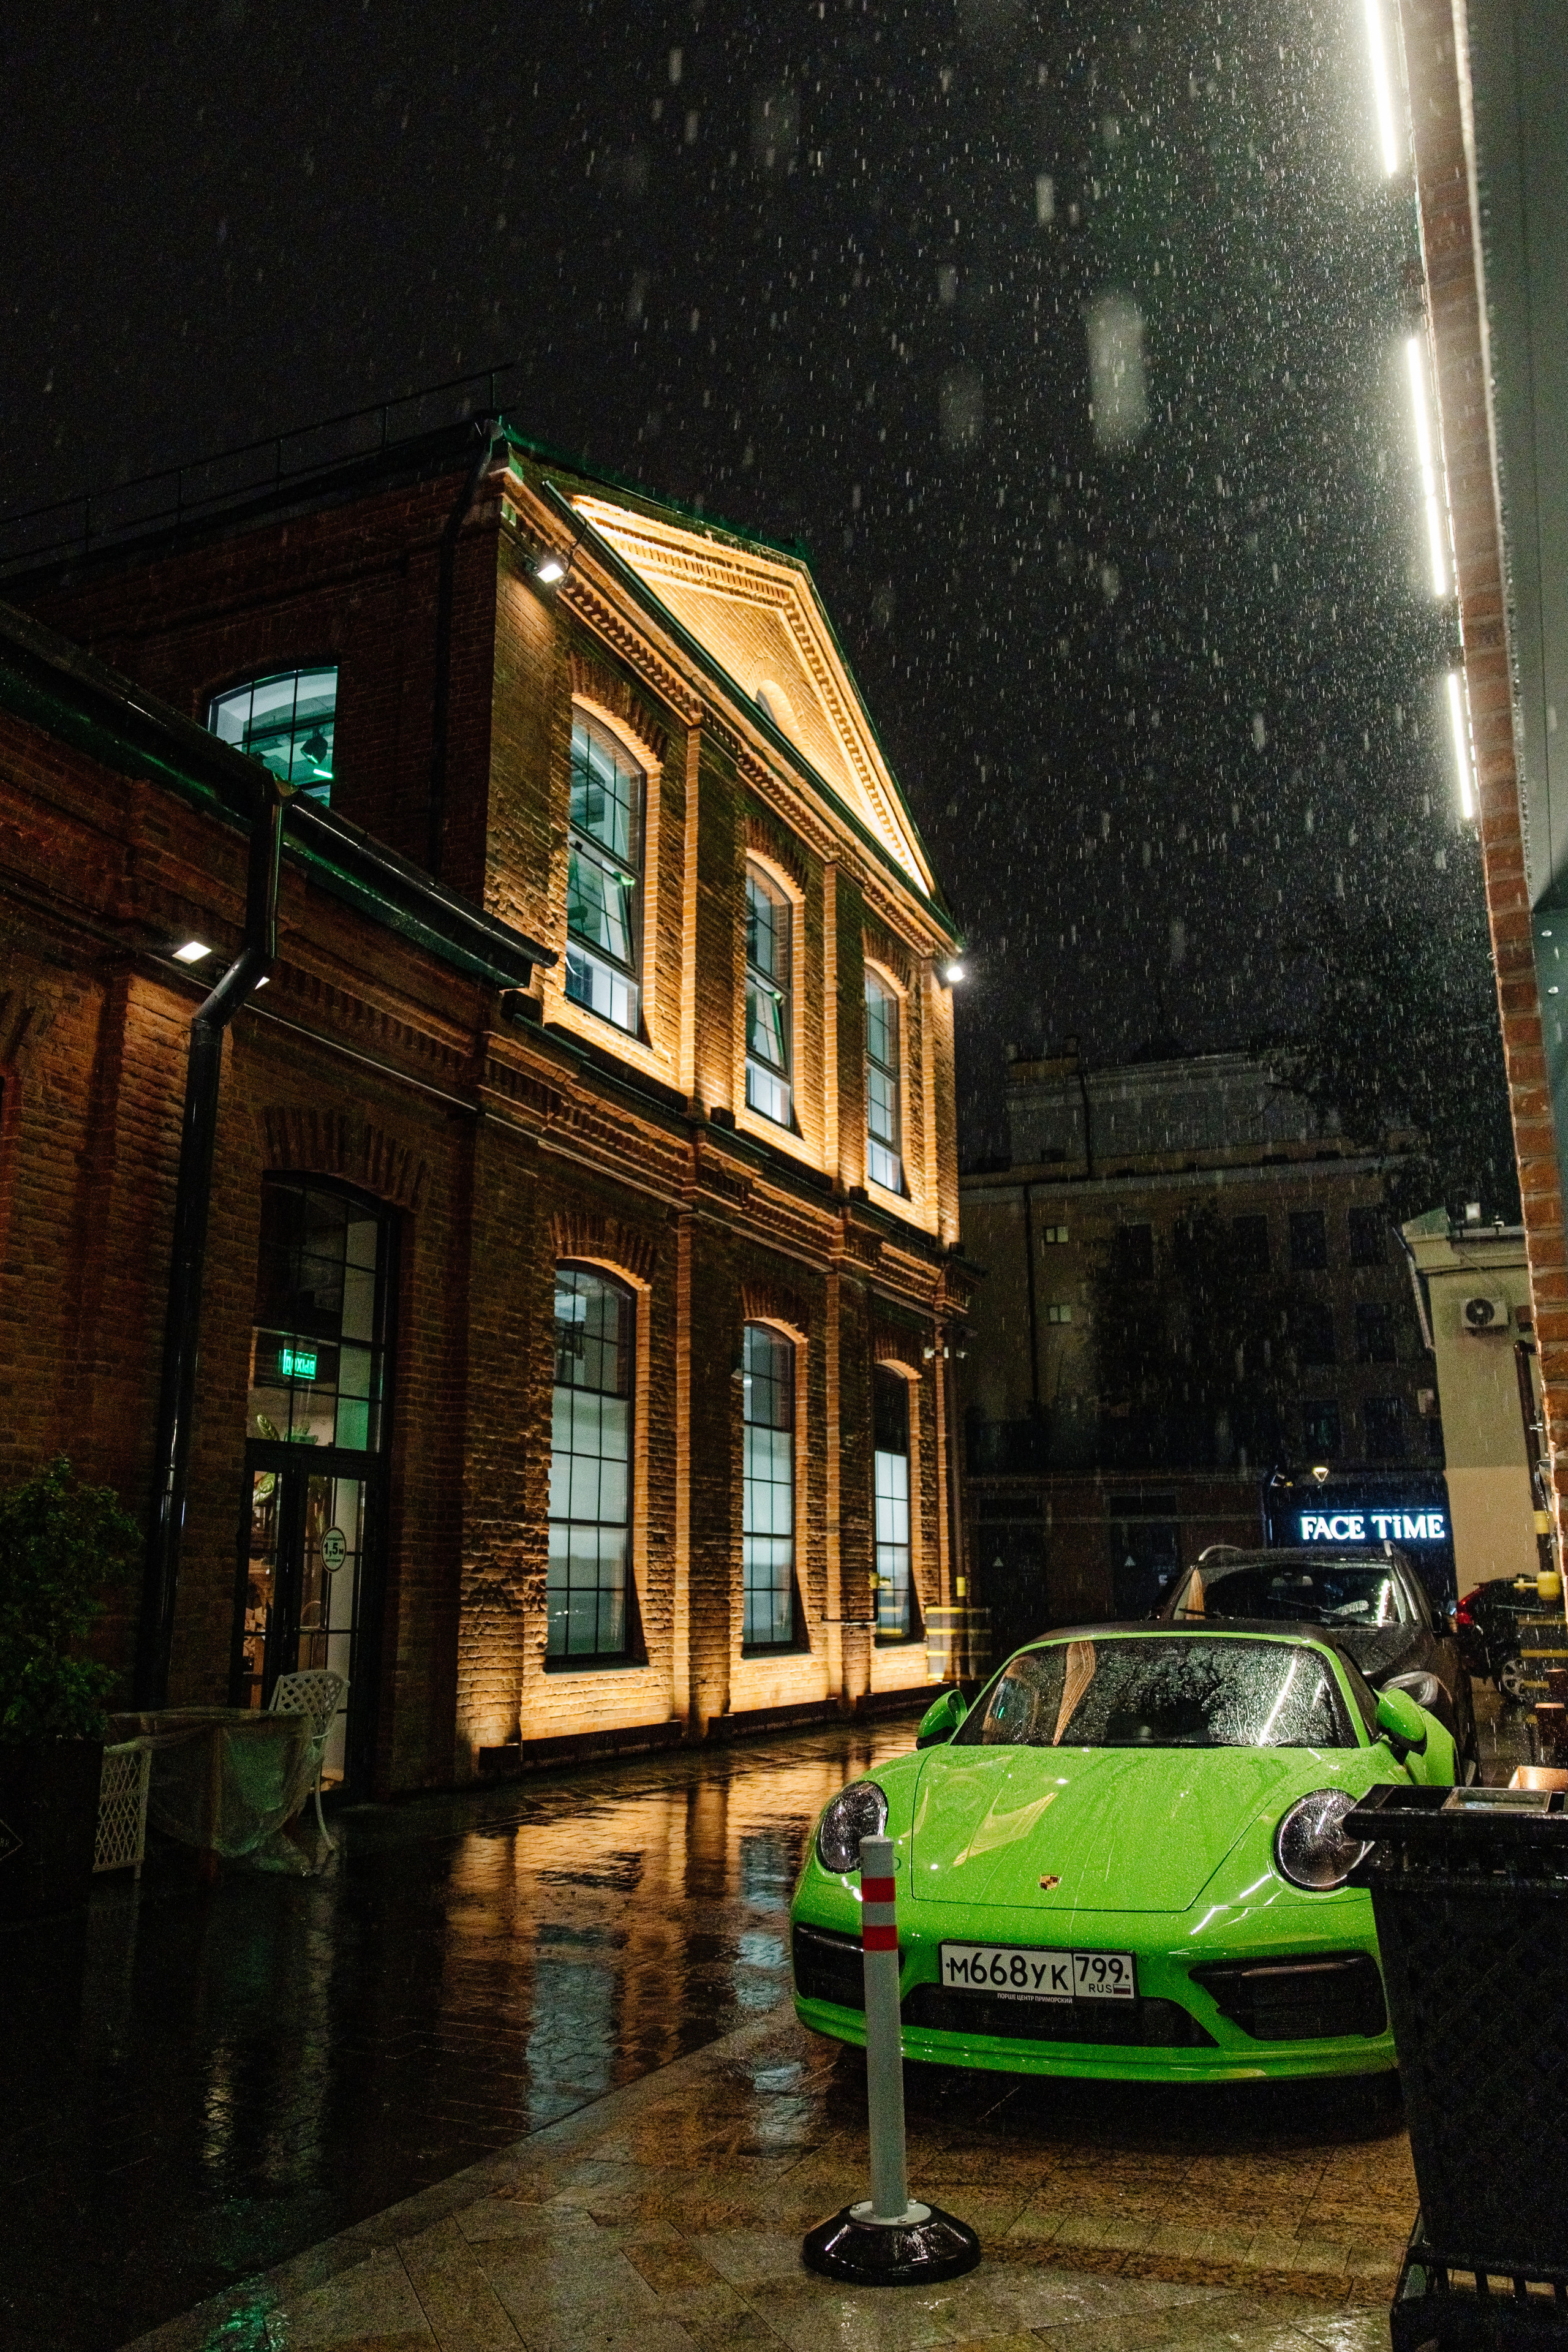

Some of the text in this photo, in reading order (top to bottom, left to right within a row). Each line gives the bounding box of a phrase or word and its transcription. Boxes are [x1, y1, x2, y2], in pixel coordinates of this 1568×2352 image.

[1301, 1516, 1365, 1540] FACE
[1075, 1956, 1123, 1983] 799
[1089, 1983, 1112, 1993] RUS
[1035, 1996, 1072, 2004] ПРИМОРСКИЙ
